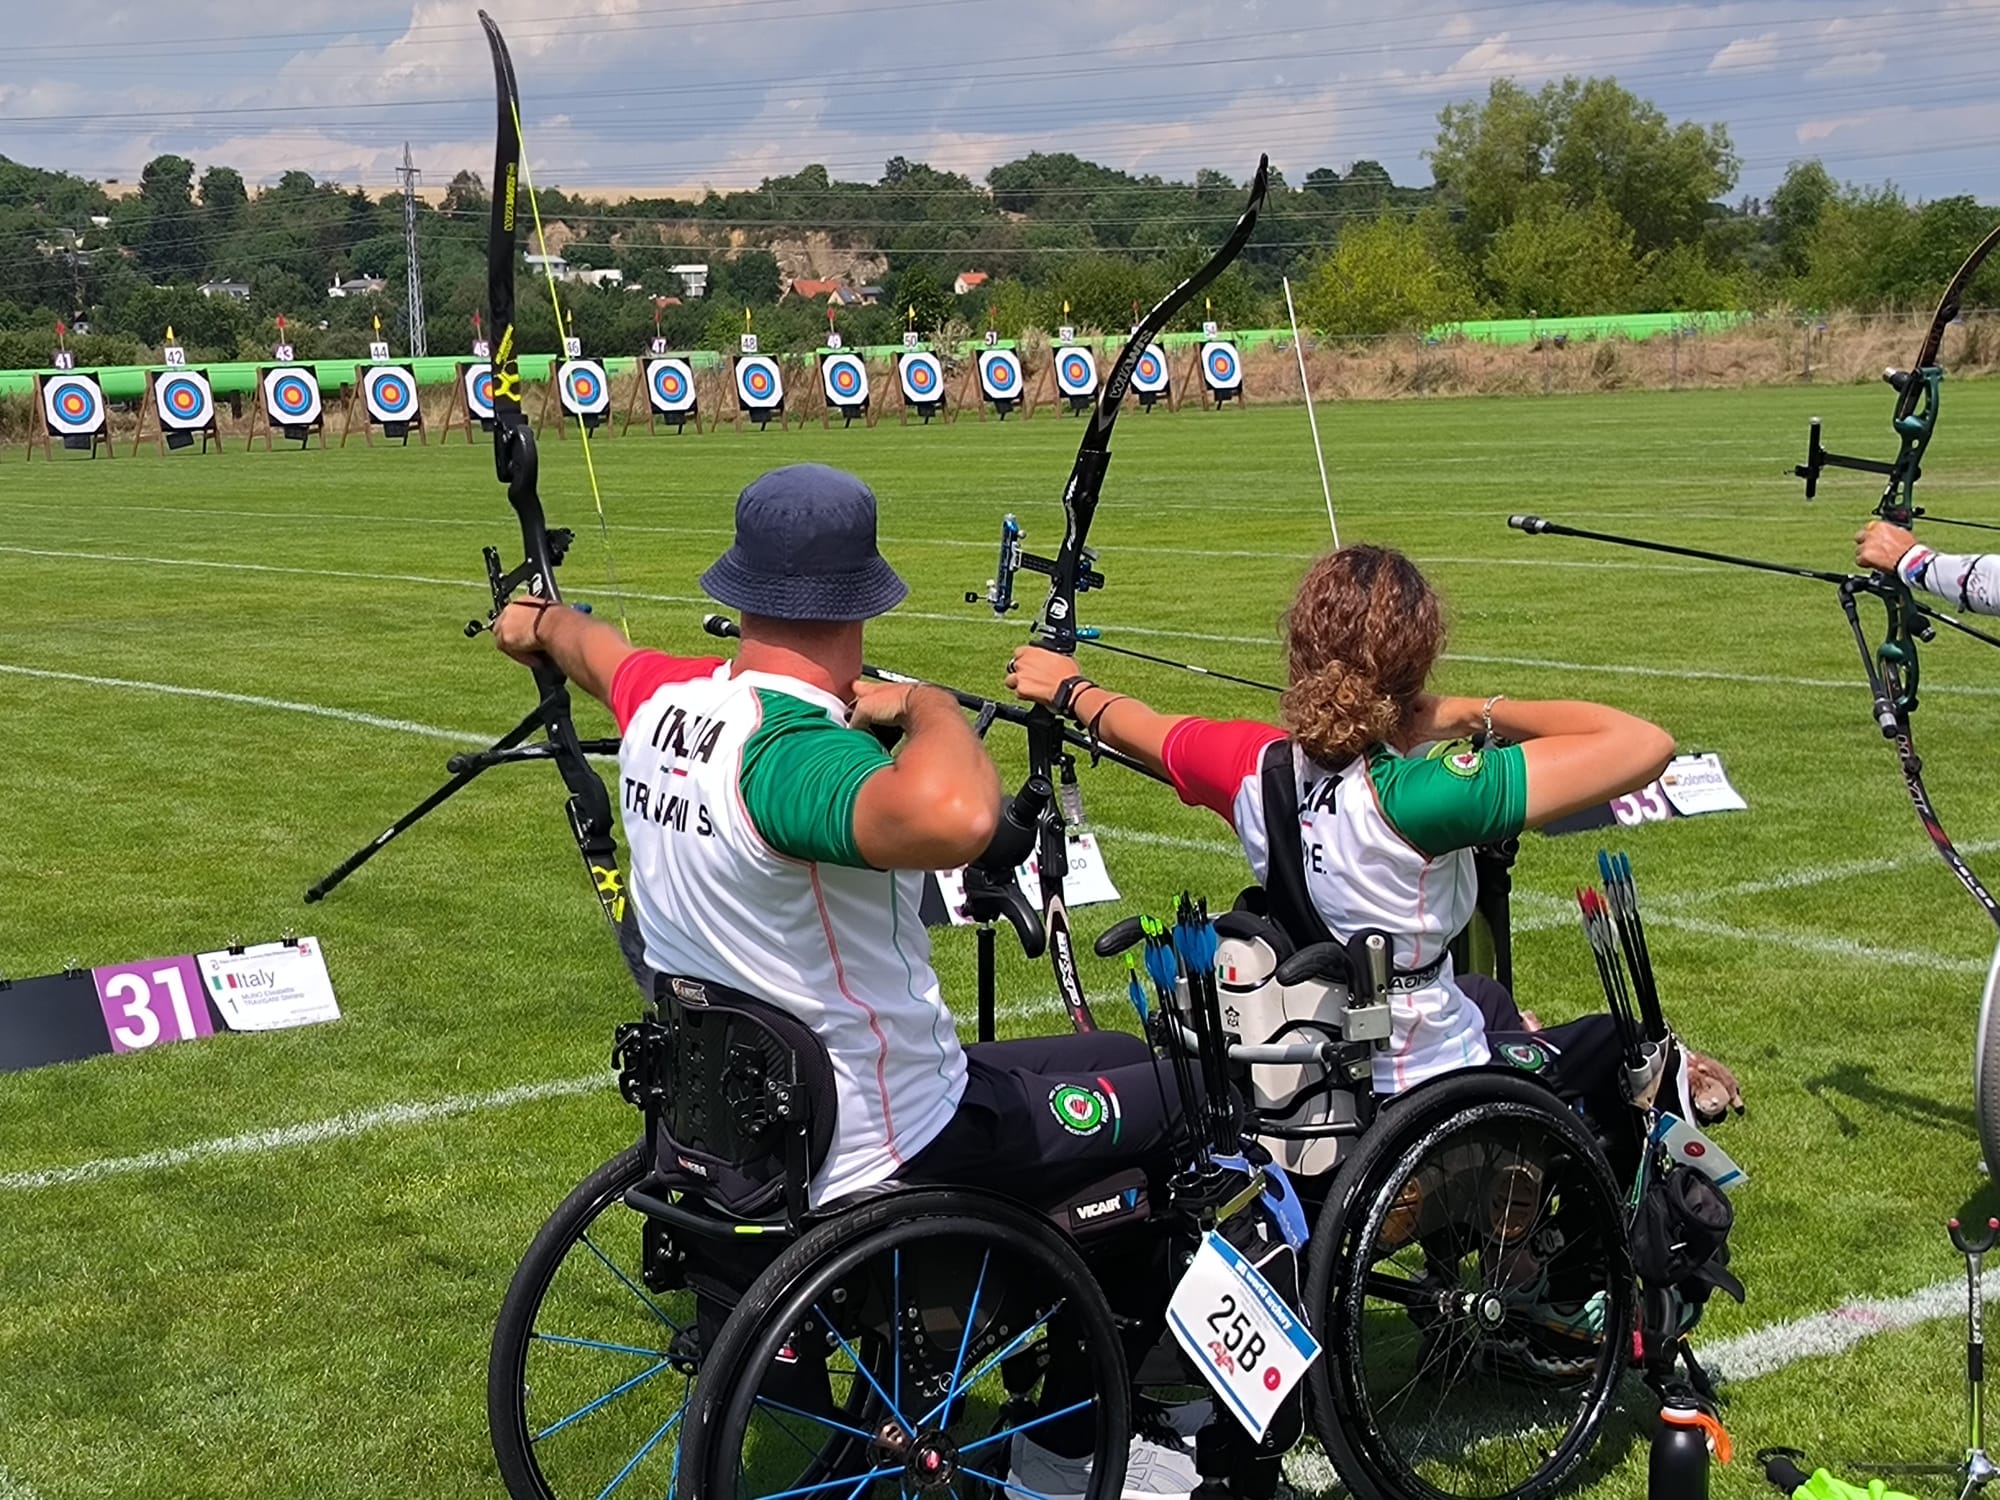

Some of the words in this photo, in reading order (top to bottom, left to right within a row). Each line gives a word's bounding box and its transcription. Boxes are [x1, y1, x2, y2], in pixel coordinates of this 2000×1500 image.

[652, 338, 667, 353] 47
[743, 337, 756, 351] 48
[905, 335, 917, 348] 50
[985, 331, 998, 346] 51
[276, 346, 294, 361] 43
[373, 346, 387, 359] 44
[473, 341, 490, 357] 45
[566, 340, 579, 354] 46
[55, 353, 72, 369] 41
[168, 350, 183, 364] 42
[1676, 772, 1722, 787] Colombia
[1896, 734, 1930, 814] HYT
[236, 968, 275, 990] Italy
[106, 966, 197, 1048] 31
[1076, 1195, 1121, 1220] VICAIR
[1244, 1268, 1268, 1299] world
[1264, 1289, 1293, 1331] archery
[1206, 1293, 1267, 1373] 25B
